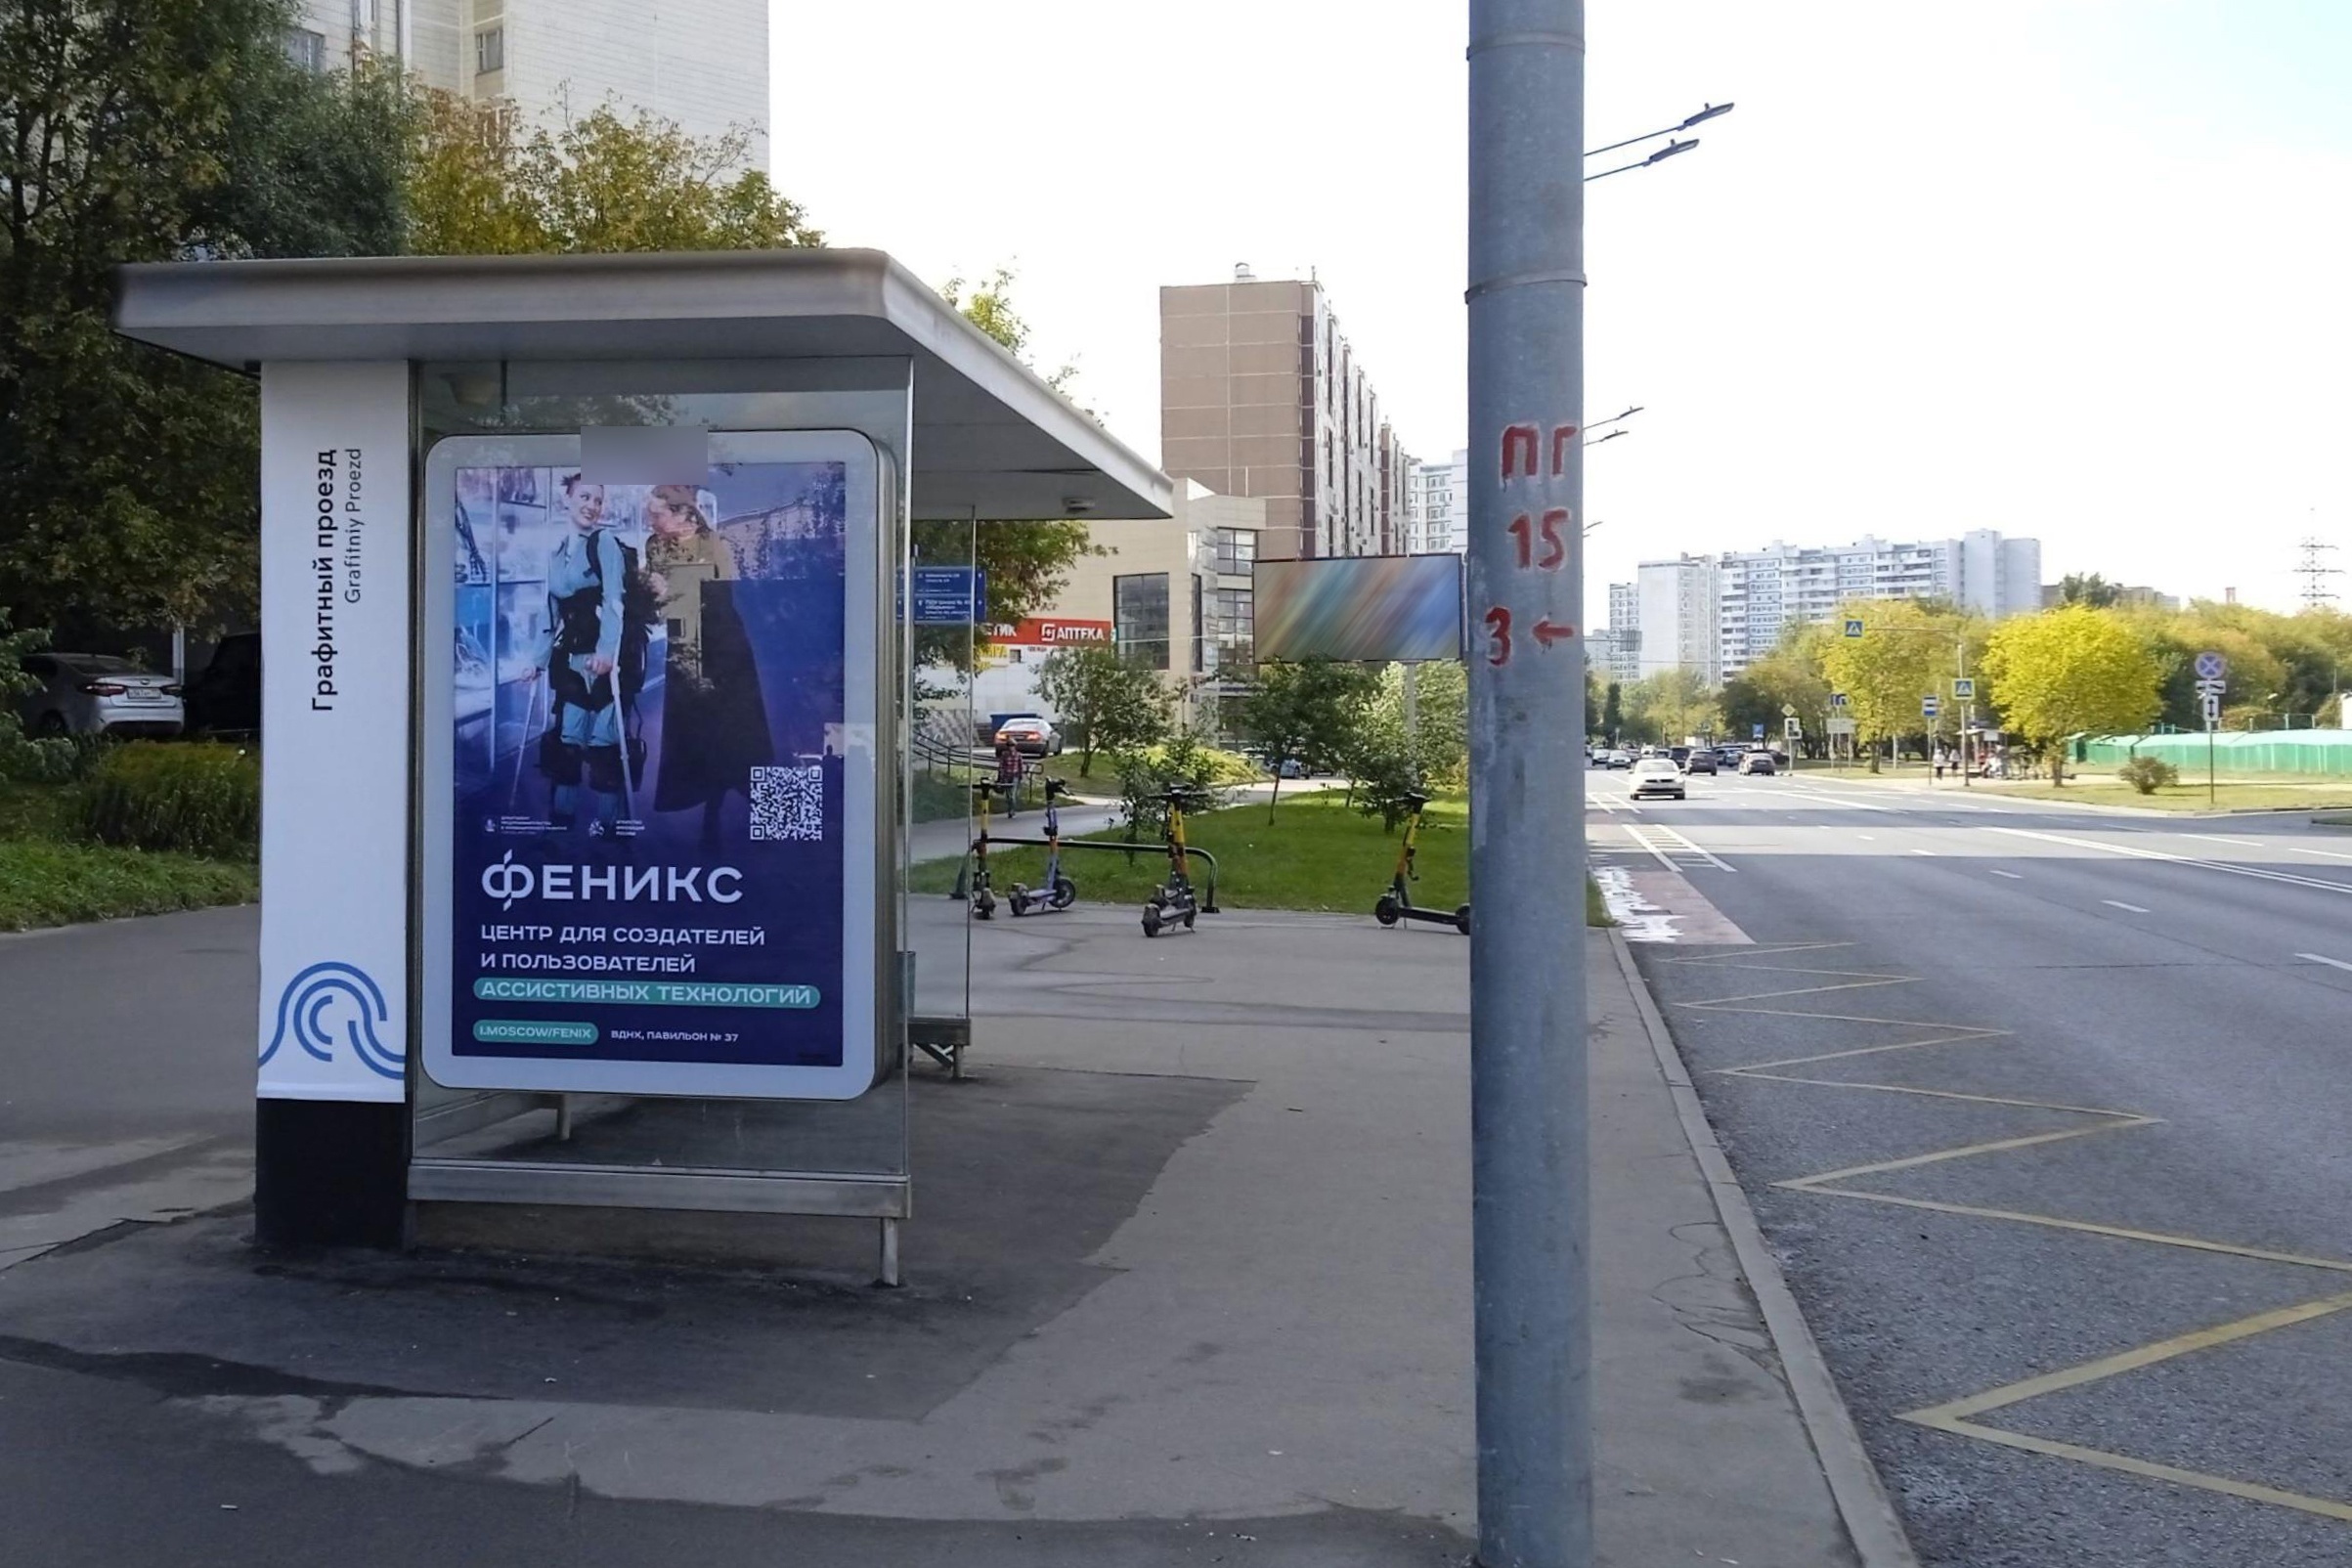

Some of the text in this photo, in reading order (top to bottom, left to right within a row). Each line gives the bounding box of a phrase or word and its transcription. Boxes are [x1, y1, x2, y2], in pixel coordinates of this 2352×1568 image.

[344, 448, 366, 603] Grafitniy Proezd
[1506, 507, 1570, 571] 15
[311, 449, 338, 711] Графитный проезд
[1057, 627, 1106, 641] АПТЕКА
[481, 849, 744, 912] ФЕНИКС
[480, 925, 765, 946] ЦЕНТР ДЛЯ СОЗДАТЕЛЕЙ
[480, 953, 696, 974] И ПОЛЬЗОВАТЕЛЕЙ
[480, 980, 811, 1005] АССИСТИВНЫХ ТЕХНОЛОГИЙ
[611, 1030, 645, 1040] ВДНХ,
[646, 1030, 708, 1041] ПАВИЛЬОН
[724, 1033, 739, 1042] 37
